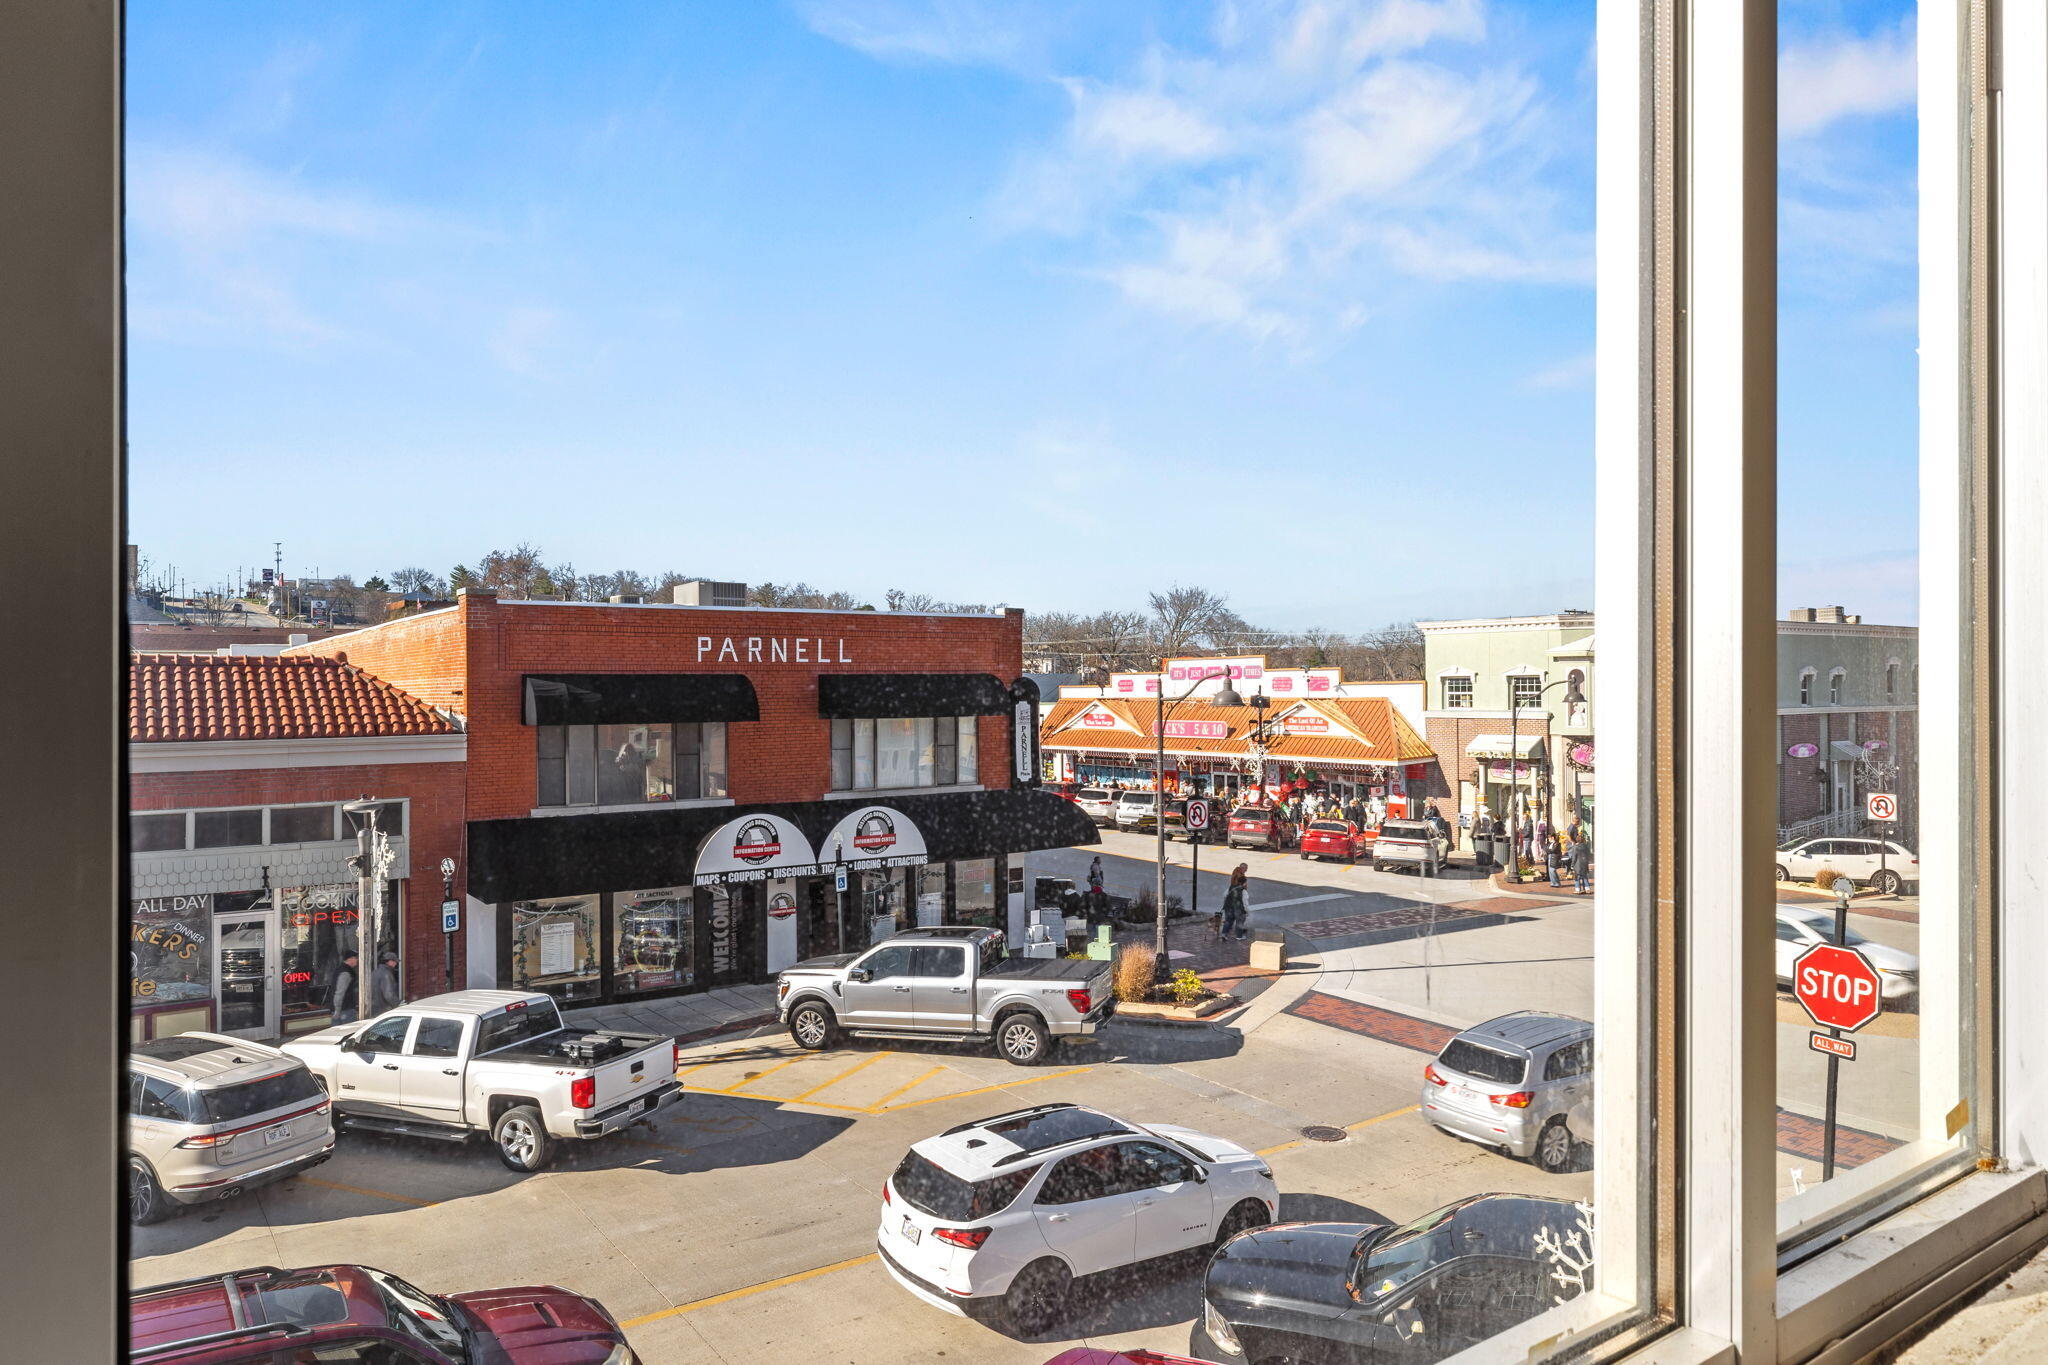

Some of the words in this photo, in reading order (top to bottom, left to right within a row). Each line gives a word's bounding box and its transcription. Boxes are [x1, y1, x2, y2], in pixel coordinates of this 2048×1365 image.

[697, 636, 853, 664] PARNELL
[1193, 723, 1200, 736] 5
[1202, 723, 1210, 736] &
[1212, 723, 1223, 736] 10
[1020, 725, 1028, 771] PARNELL
[821, 862, 848, 874] TICK
[854, 859, 881, 871] LODGING
[887, 855, 928, 868] ATTRACTIONS
[696, 874, 720, 886] MAPS
[728, 870, 766, 884] COUPONS
[773, 865, 817, 879] DISCOUNTS
[286, 892, 361, 911] COOKIN
[636, 890, 674, 899] ATTACTIONS
[136, 898, 168, 914] ALL
[173, 895, 208, 912] DAY
[173, 922, 205, 944] DINNER
[284, 972, 311, 983] OPEN
[1801, 966, 1873, 1006] STOP
[1815, 1037, 1830, 1050] ALL
[1833, 1042, 1850, 1054] WAY
